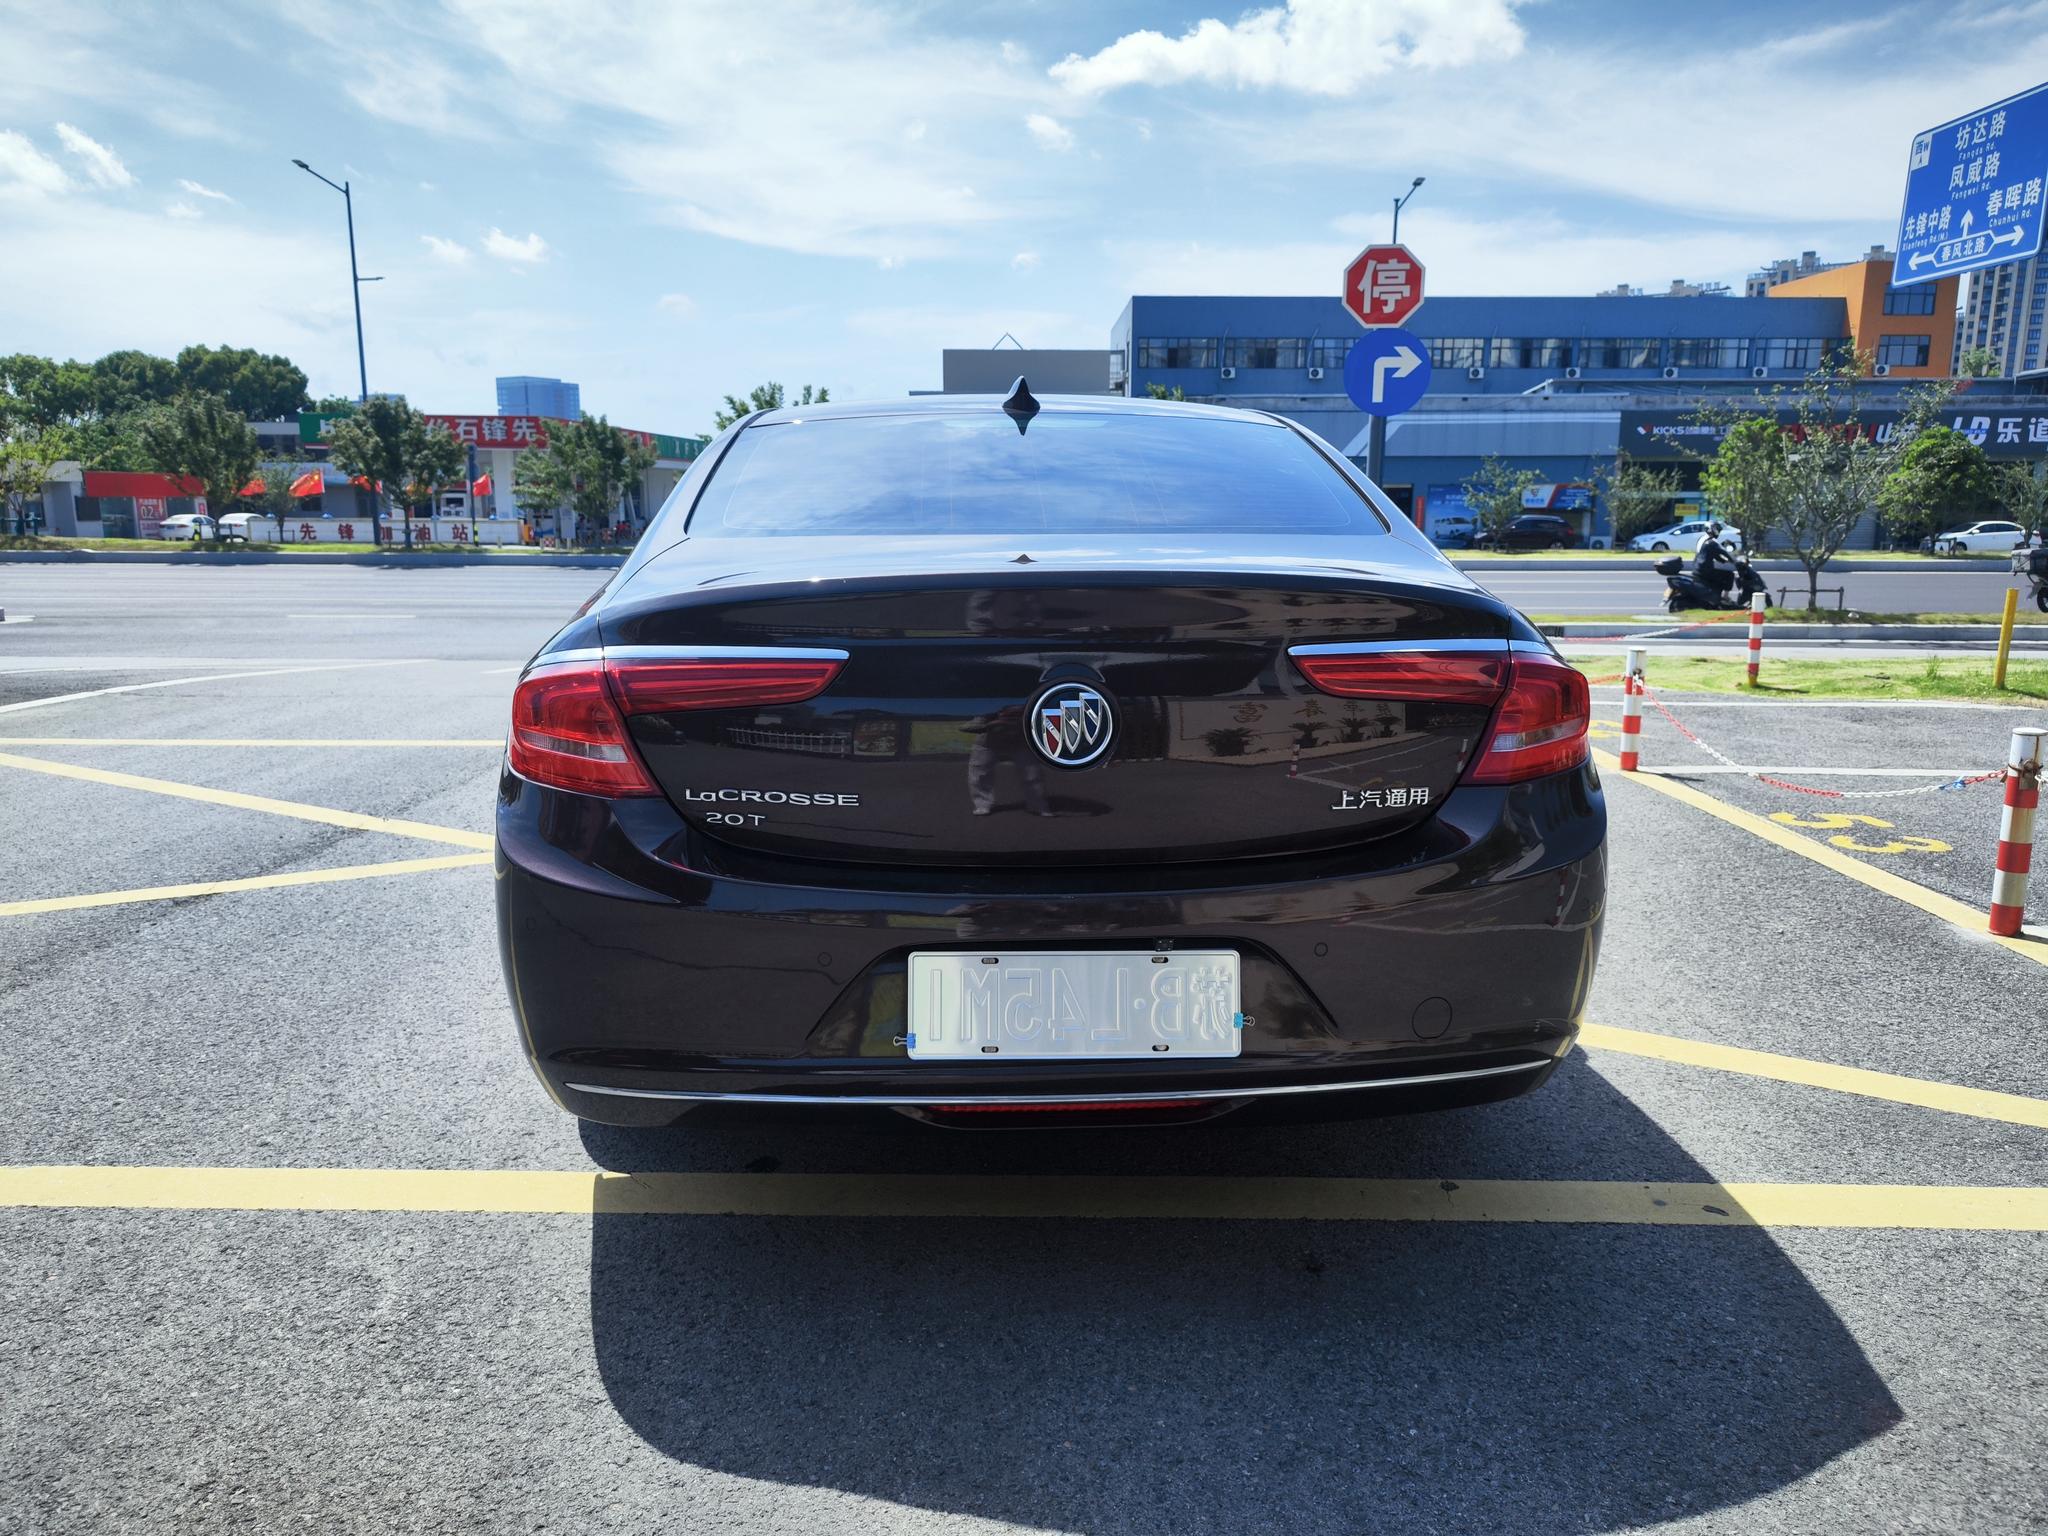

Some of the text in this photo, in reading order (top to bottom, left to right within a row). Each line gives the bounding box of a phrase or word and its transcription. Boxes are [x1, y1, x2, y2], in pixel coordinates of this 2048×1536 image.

[1955, 109, 2007, 151] 坊达路
[1948, 151, 2001, 191] 凤威路
[1986, 177, 2042, 218] 春晖路
[1904, 204, 1952, 241] 先锋中路
[1357, 258, 1411, 314] 停
[1653, 425, 1685, 435] KICKS
[1997, 416, 2048, 444] 乐道
[685, 788, 860, 806] LaCROSSE
[1331, 787, 1429, 810] 上汽通用
[705, 812, 766, 826] 20T
